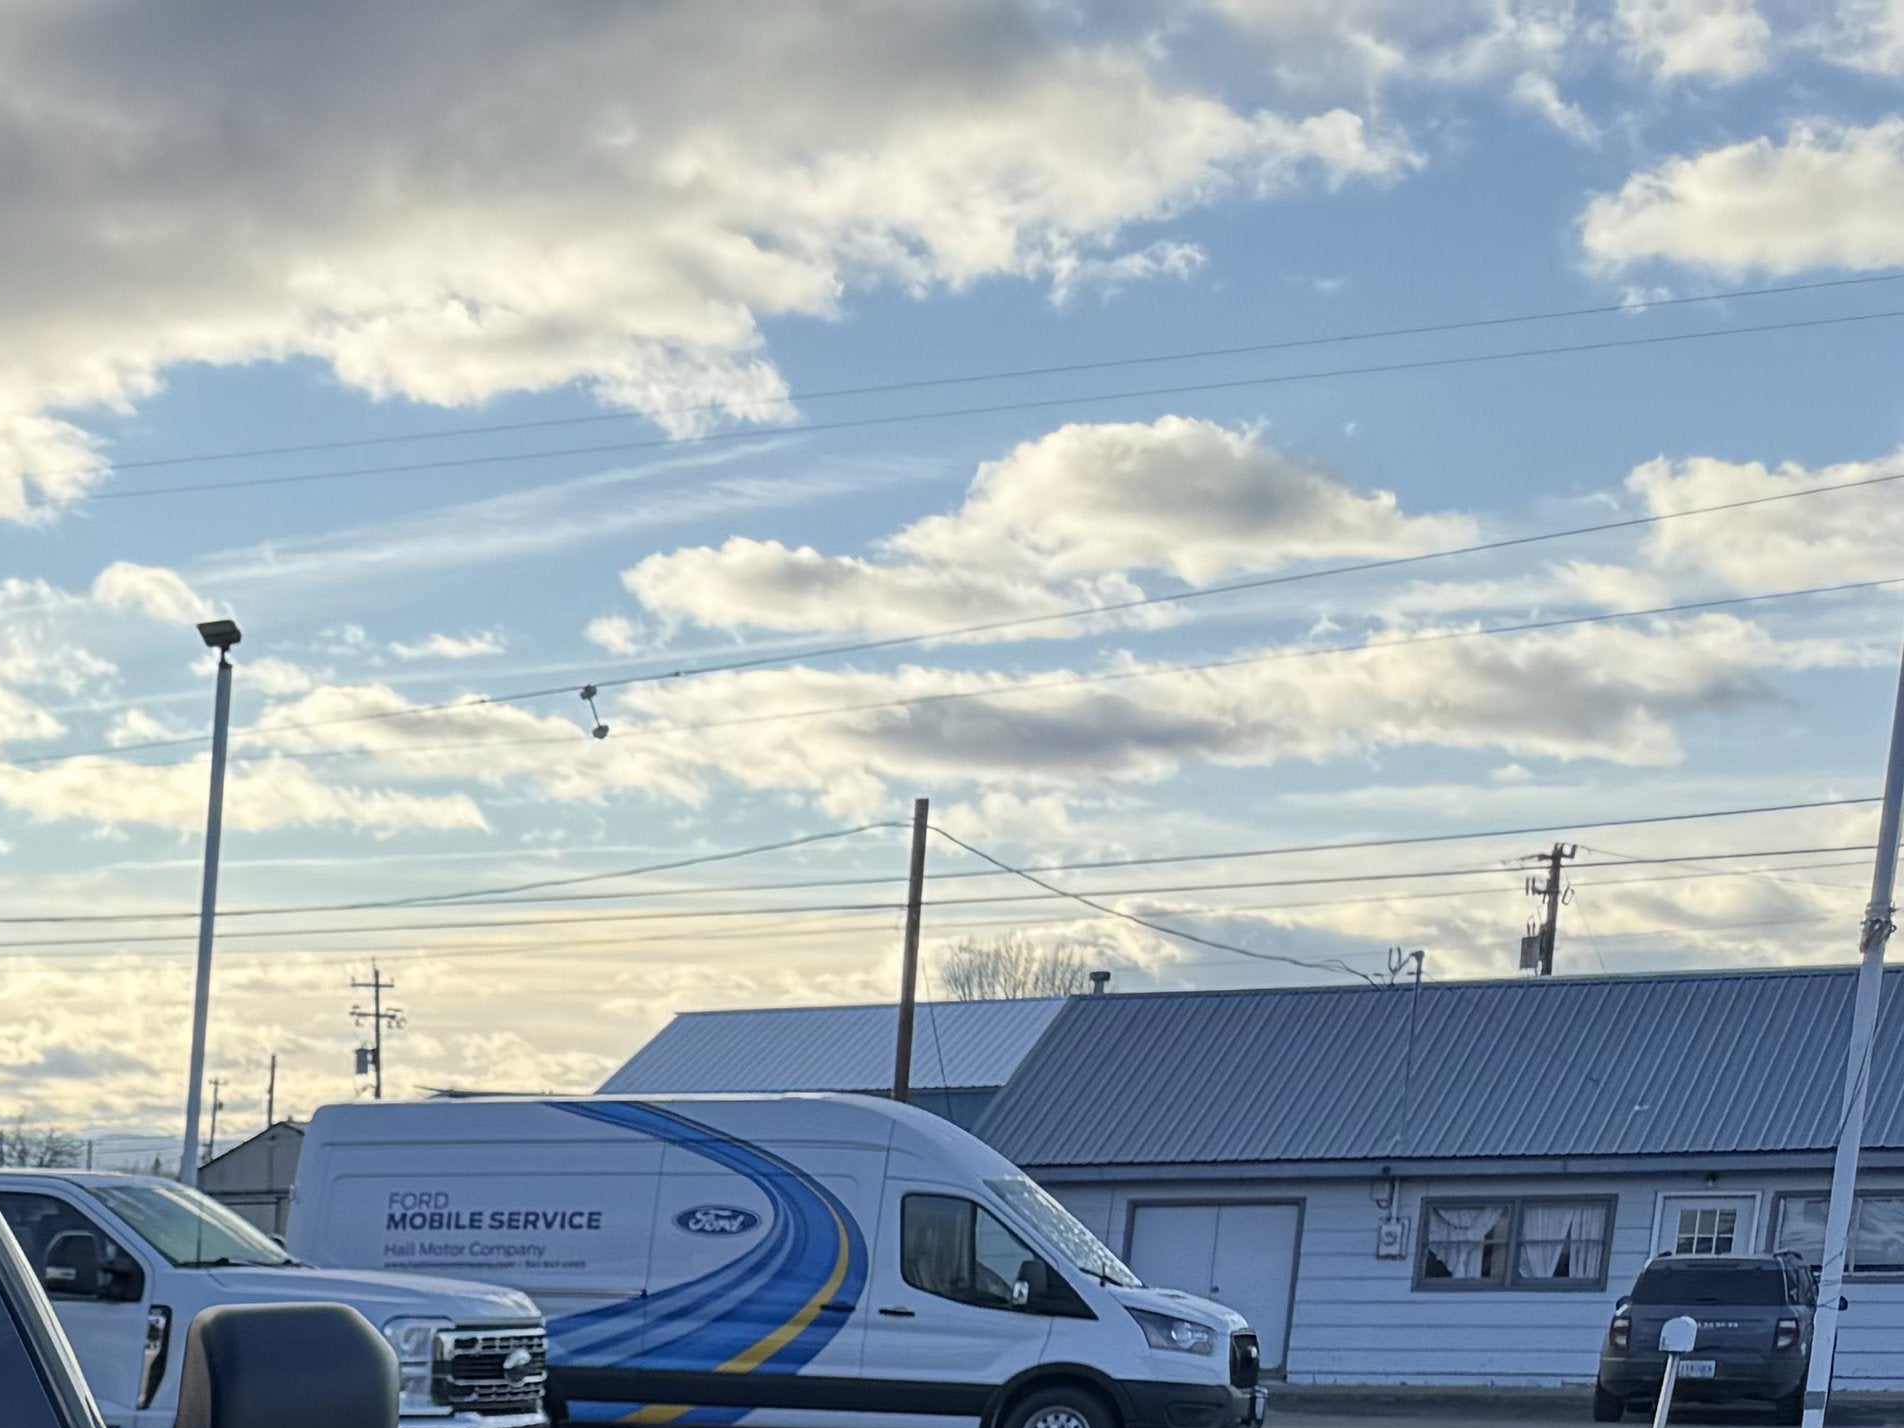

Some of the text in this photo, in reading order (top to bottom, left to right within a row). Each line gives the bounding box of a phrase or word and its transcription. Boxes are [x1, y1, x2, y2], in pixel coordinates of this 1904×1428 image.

[388, 1191, 450, 1211] FORD
[386, 1211, 603, 1231] MOBILE SERVICE
[688, 1209, 745, 1232] Ford
[383, 1241, 546, 1258] Hall Motor Company
